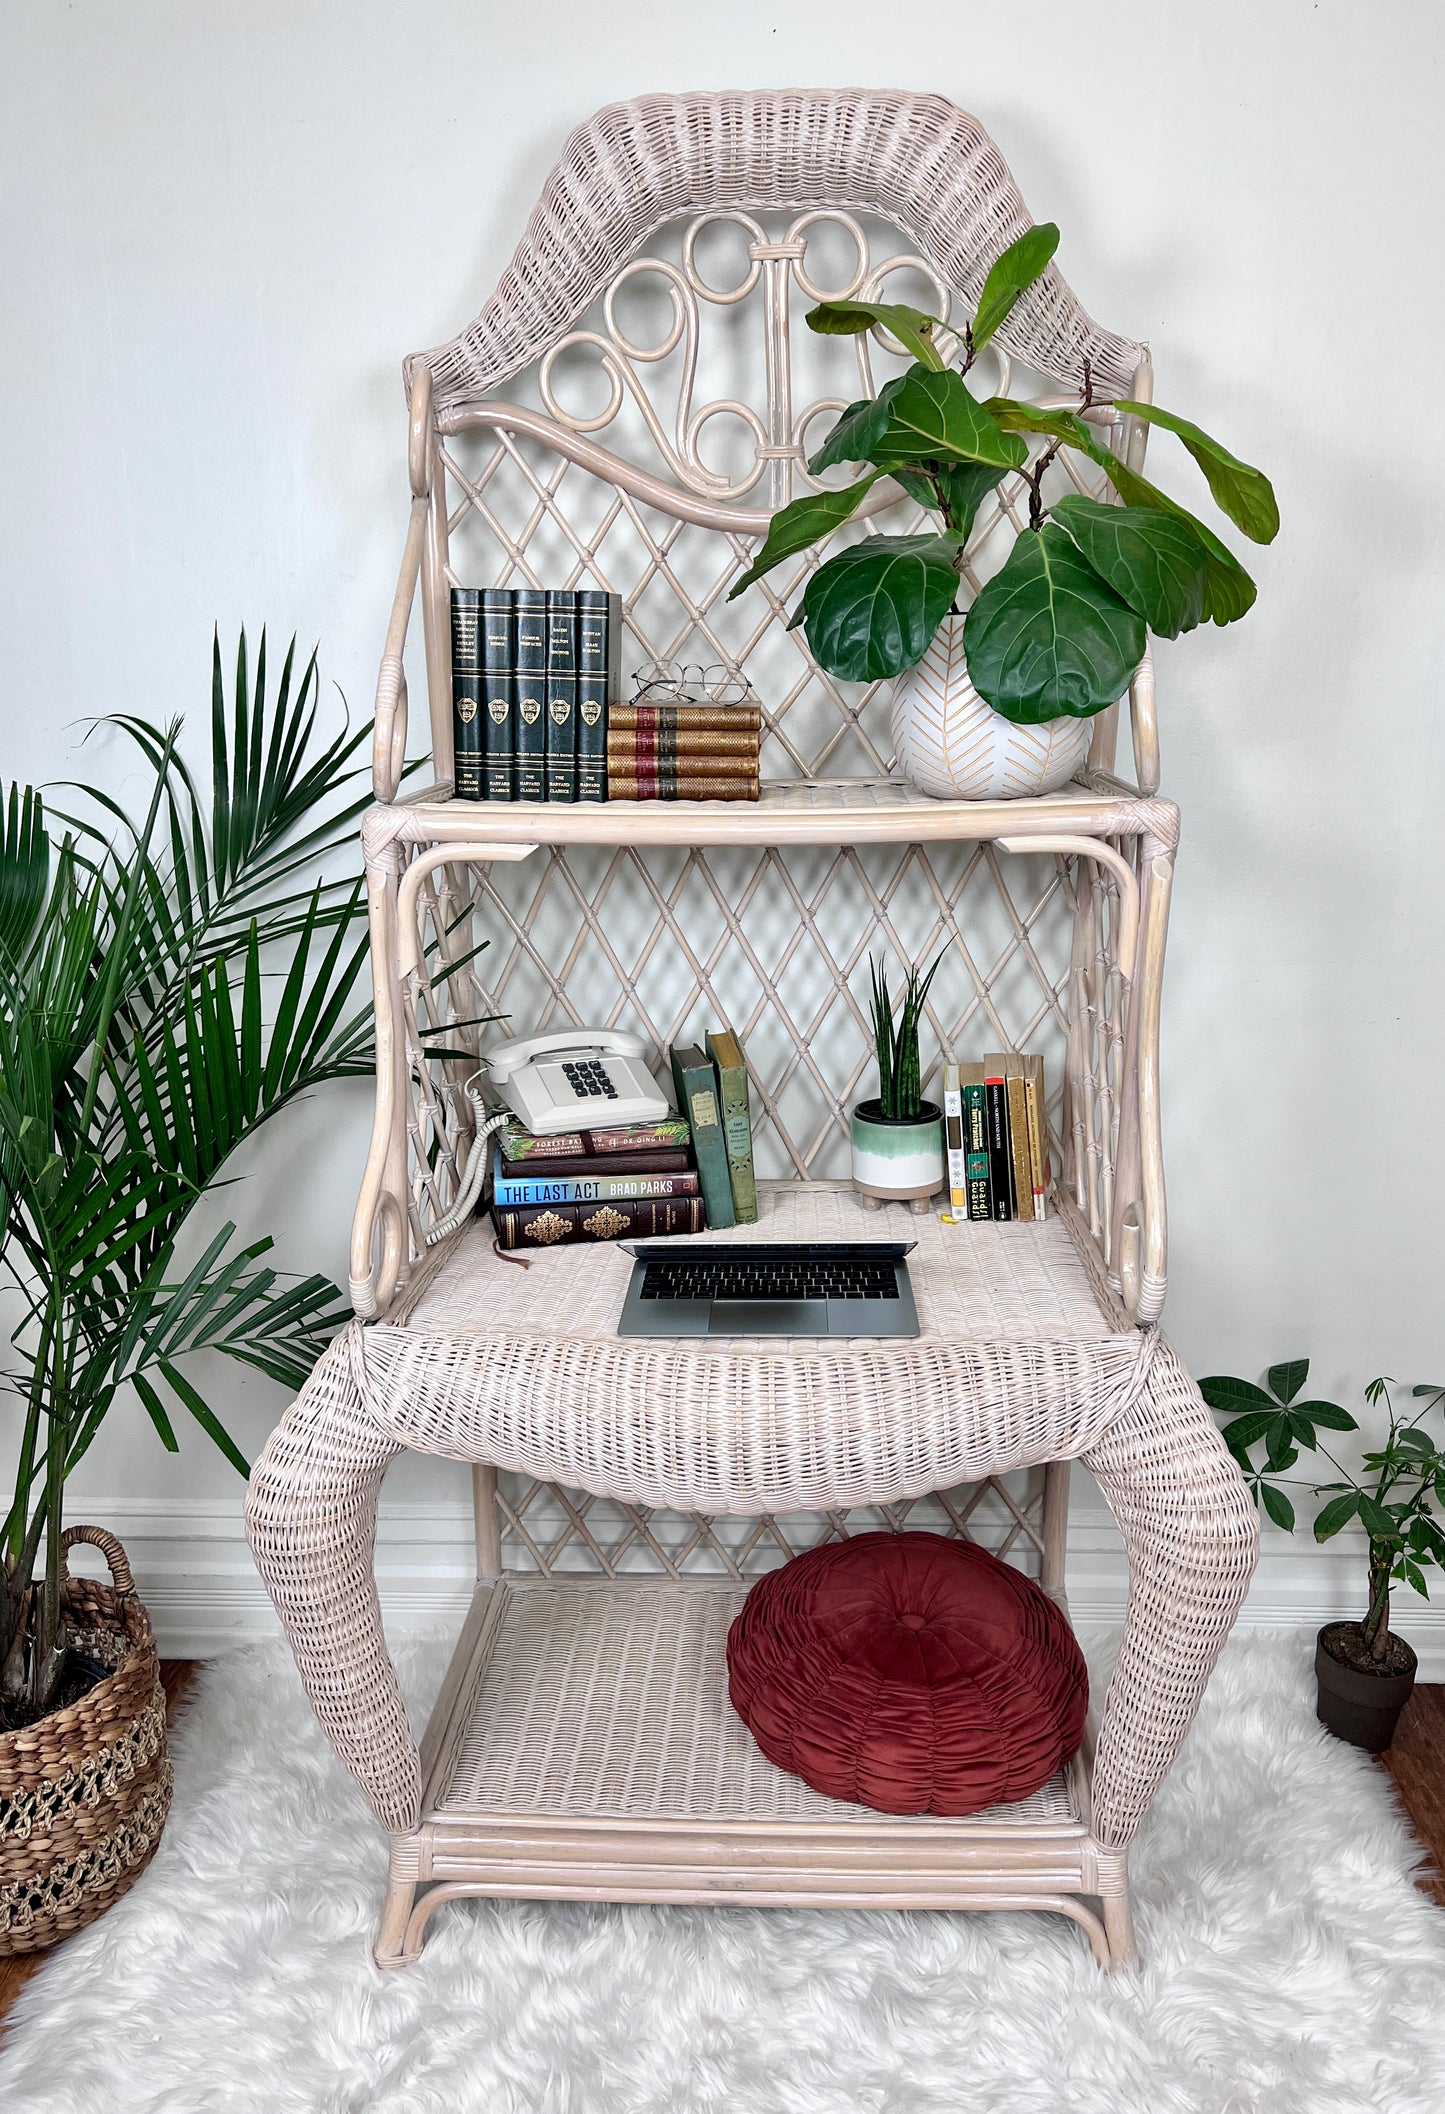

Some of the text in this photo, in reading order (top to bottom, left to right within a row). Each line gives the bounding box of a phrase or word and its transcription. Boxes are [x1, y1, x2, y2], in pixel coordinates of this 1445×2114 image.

[536, 1140, 565, 1148] FOREST
[504, 1182, 600, 1203] THE LAST ACT
[610, 1180, 673, 1196] BRAD PARKS
